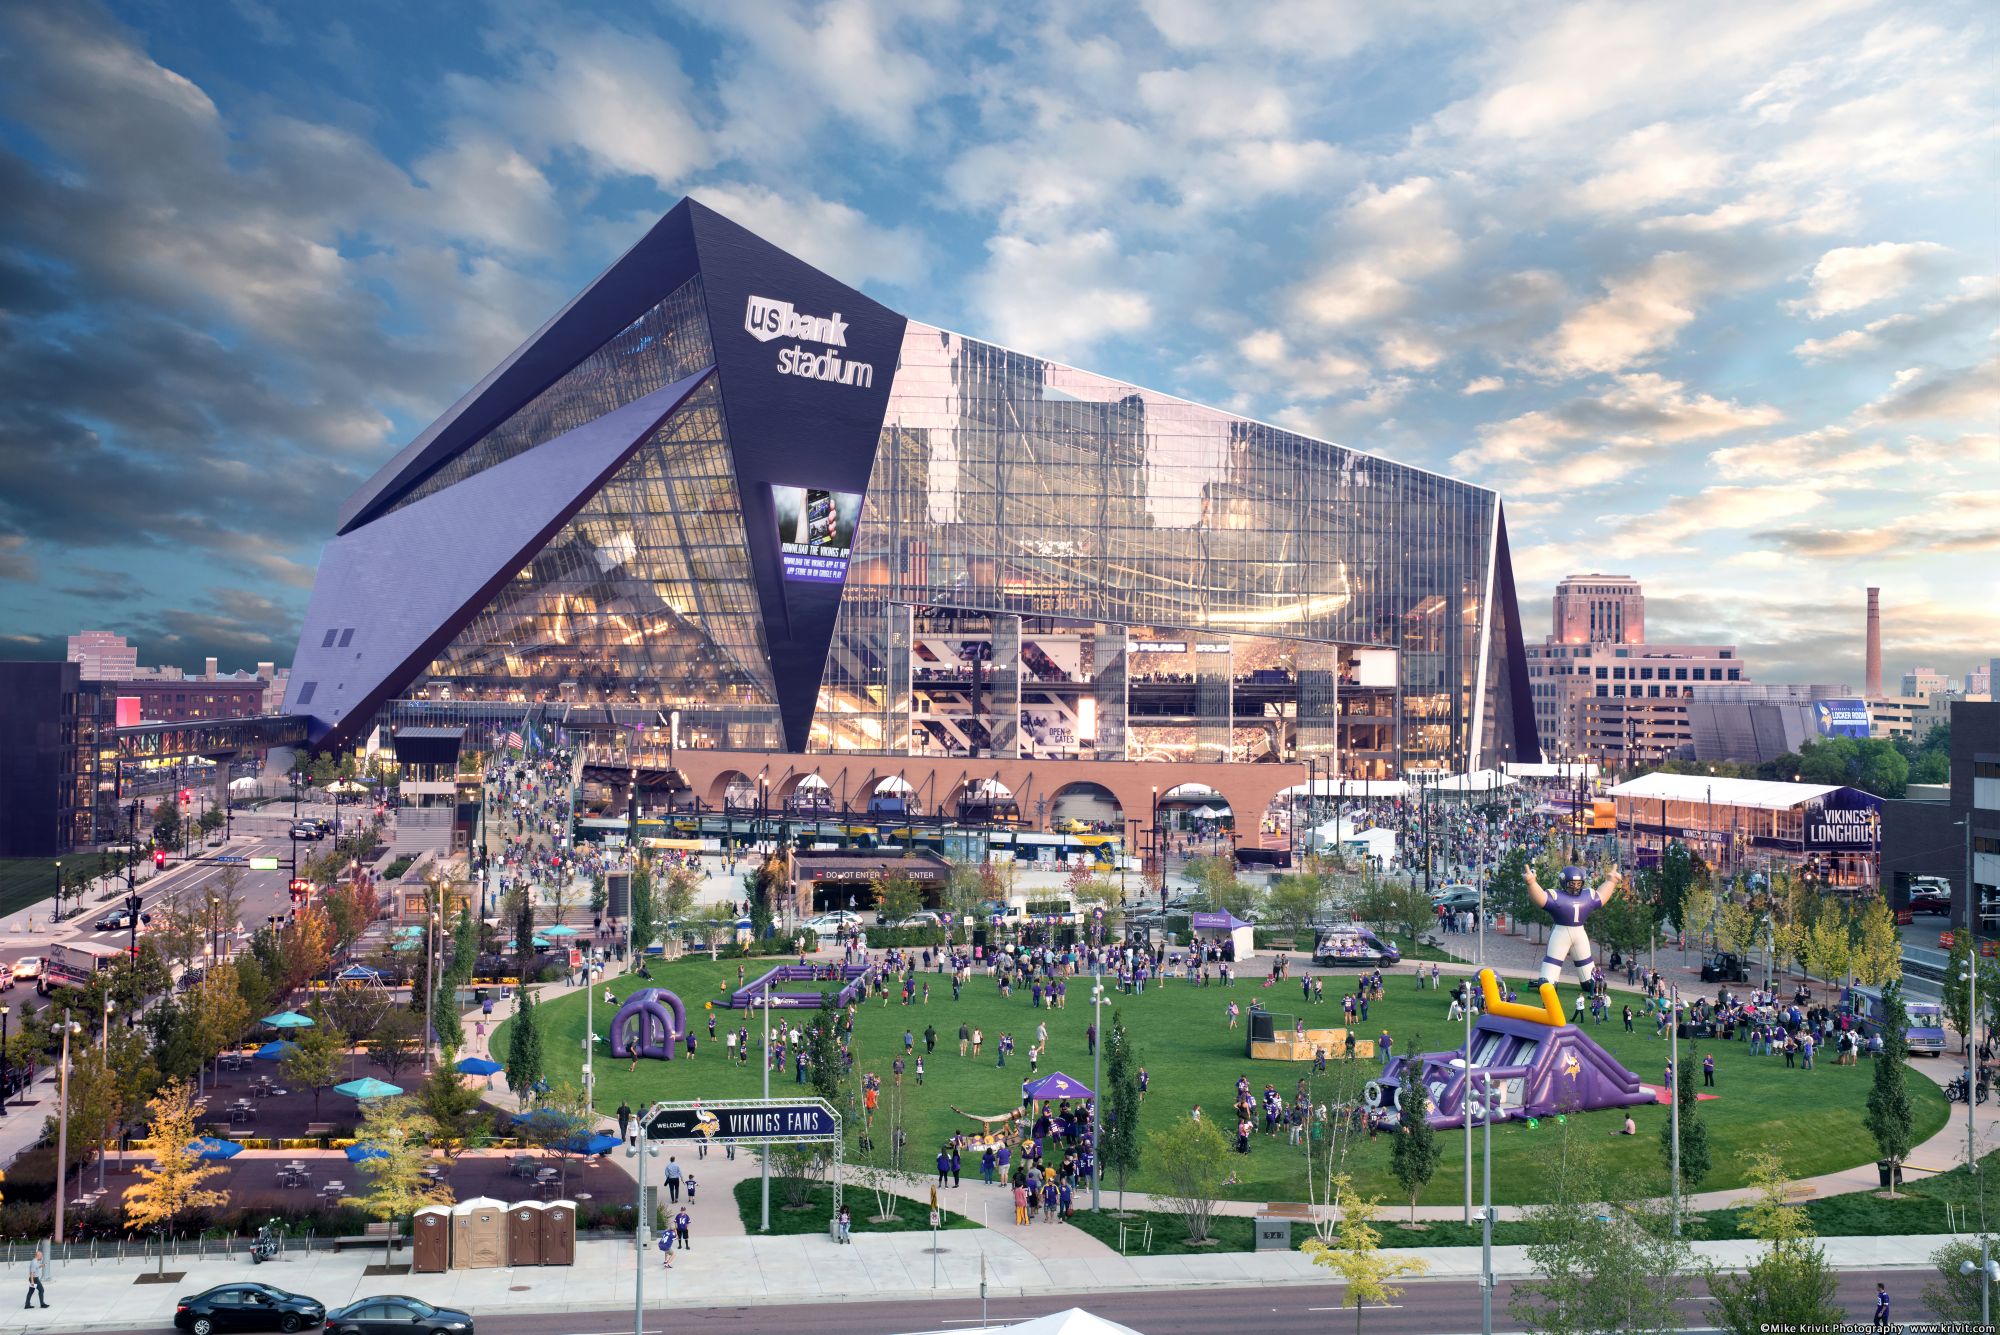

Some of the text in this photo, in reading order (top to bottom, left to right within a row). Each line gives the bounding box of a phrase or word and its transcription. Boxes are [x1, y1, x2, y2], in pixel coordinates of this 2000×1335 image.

[776, 345, 873, 388] stadium
[782, 543, 850, 558] DOWNLOAD THE VIKINGS APP
[834, 561, 839, 569] AT
[786, 567, 795, 575] APP
[833, 570, 842, 578] PLAY
[1139, 643, 1186, 652] POLARIS
[1832, 712, 1867, 720] LOCKER ROOM
[1049, 727, 1066, 736] OPEN
[1055, 736, 1074, 744] GATES
[1824, 809, 1866, 824] VIKINGS
[1573, 904, 1580, 922] 1
[729, 1113, 780, 1133] VIKINGS
[788, 1112, 819, 1131] FANS
